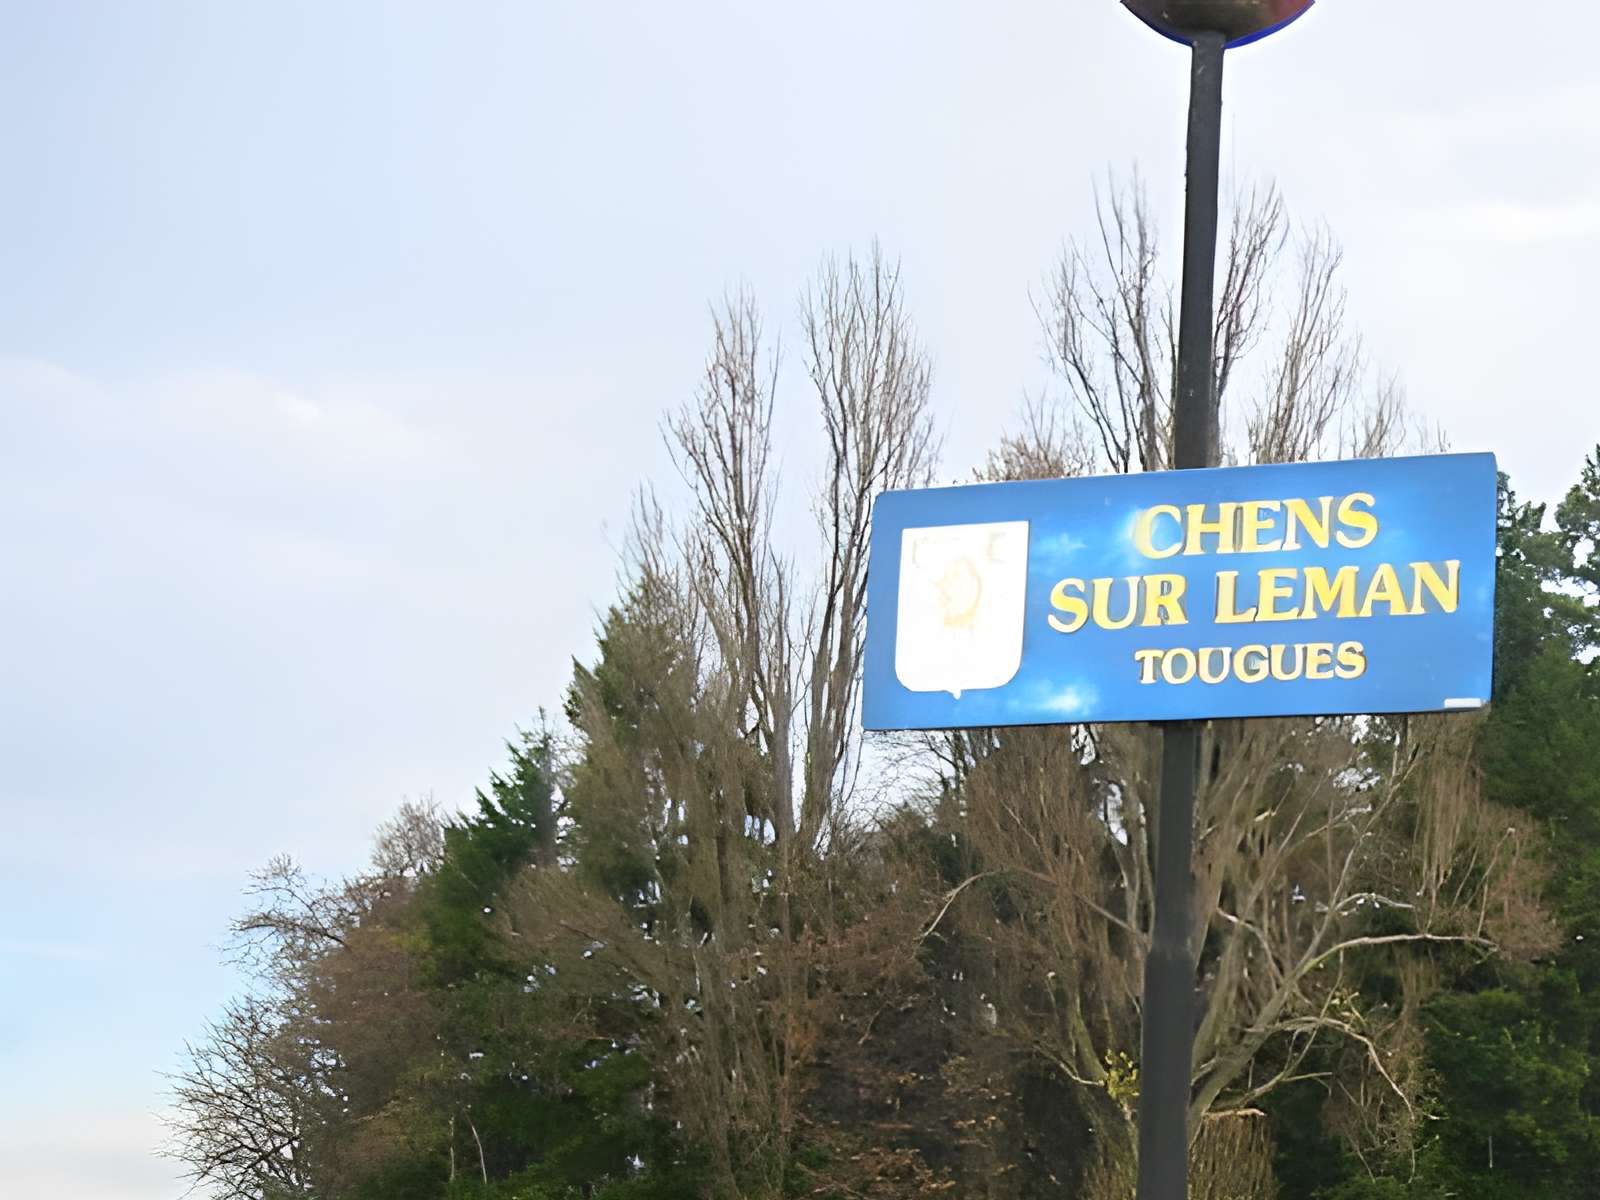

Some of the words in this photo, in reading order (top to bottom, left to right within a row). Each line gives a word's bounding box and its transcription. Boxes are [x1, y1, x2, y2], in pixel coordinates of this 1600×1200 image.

[1134, 492, 1379, 559] CHENS
[1047, 573, 1189, 633] SUR
[1214, 560, 1461, 624] LEMAN
[1134, 641, 1366, 684] TOUGUES
